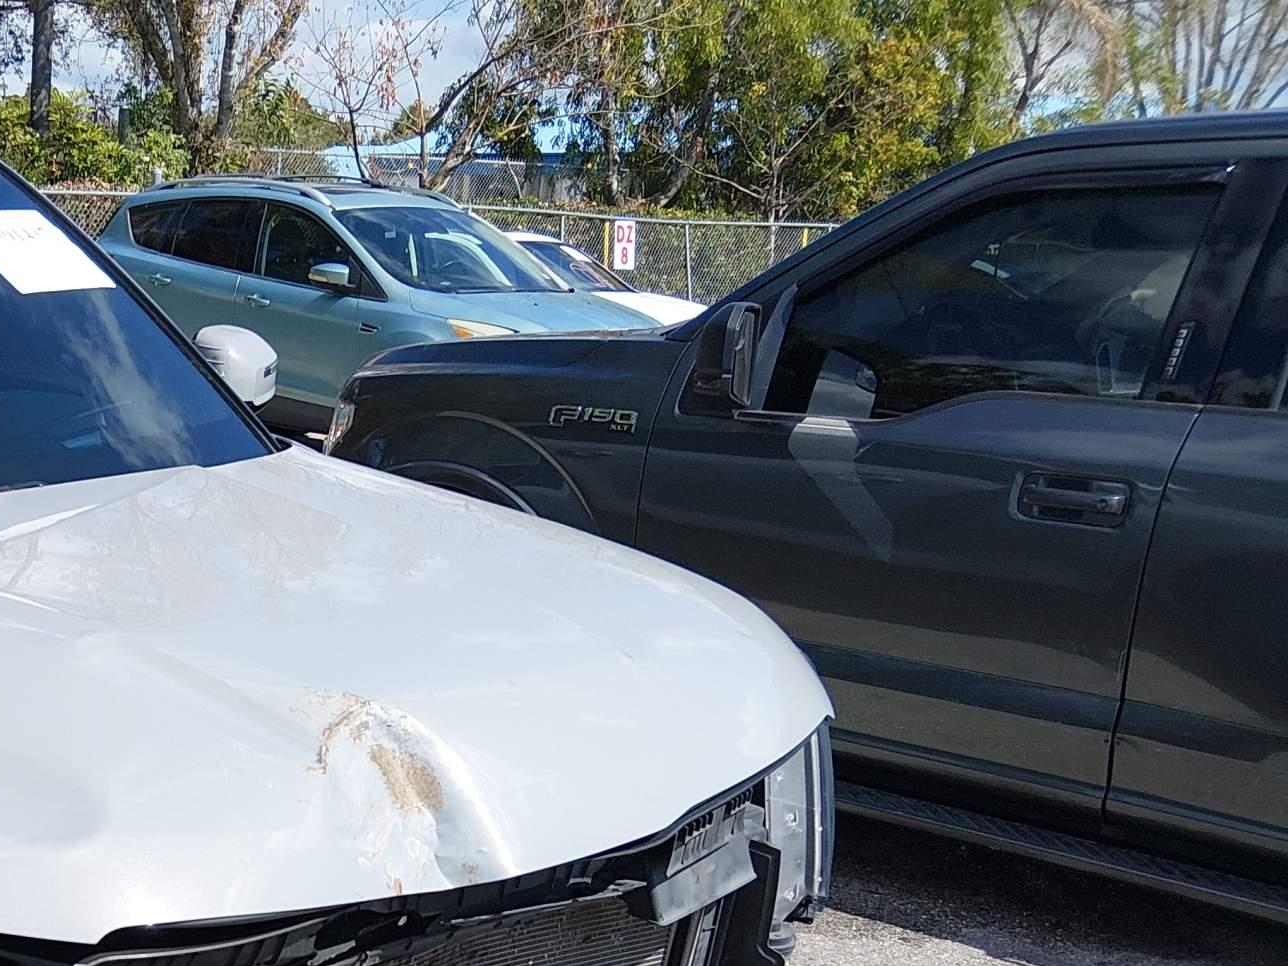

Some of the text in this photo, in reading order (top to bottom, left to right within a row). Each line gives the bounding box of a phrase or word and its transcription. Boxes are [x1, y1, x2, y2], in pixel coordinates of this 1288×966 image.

[616, 224, 633, 244] DZ
[621, 246, 629, 265] 8
[609, 423, 630, 432] XLT
